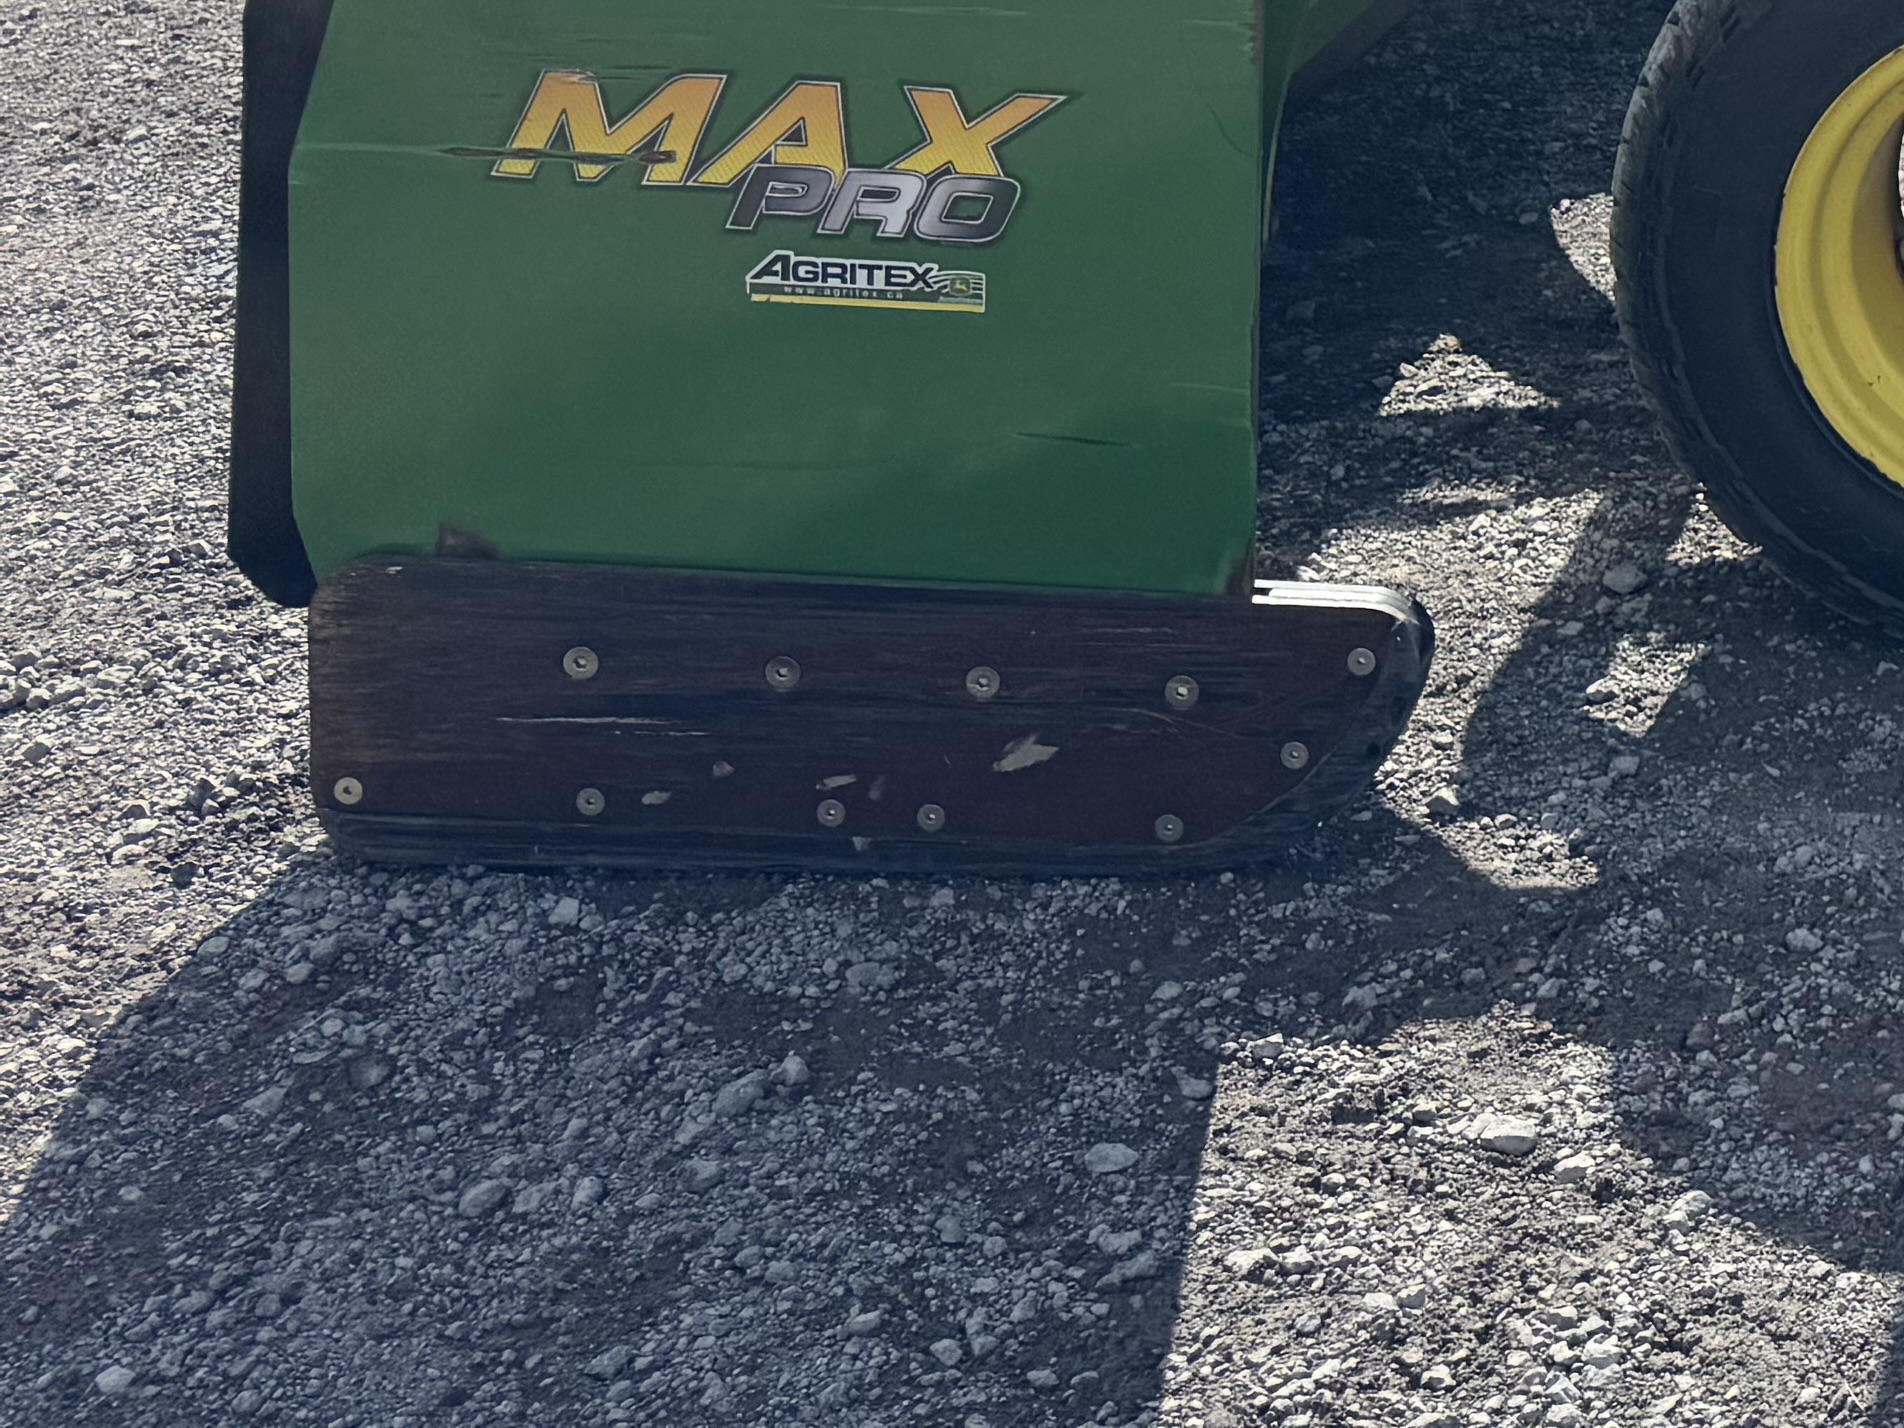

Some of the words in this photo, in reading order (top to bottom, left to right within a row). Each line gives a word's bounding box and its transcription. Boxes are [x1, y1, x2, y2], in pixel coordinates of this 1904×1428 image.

[489, 68, 1068, 188] MAX
[725, 164, 1022, 243] PRO
[749, 253, 940, 290] AGRITEX
[784, 285, 904, 300] www.agritex.ca
